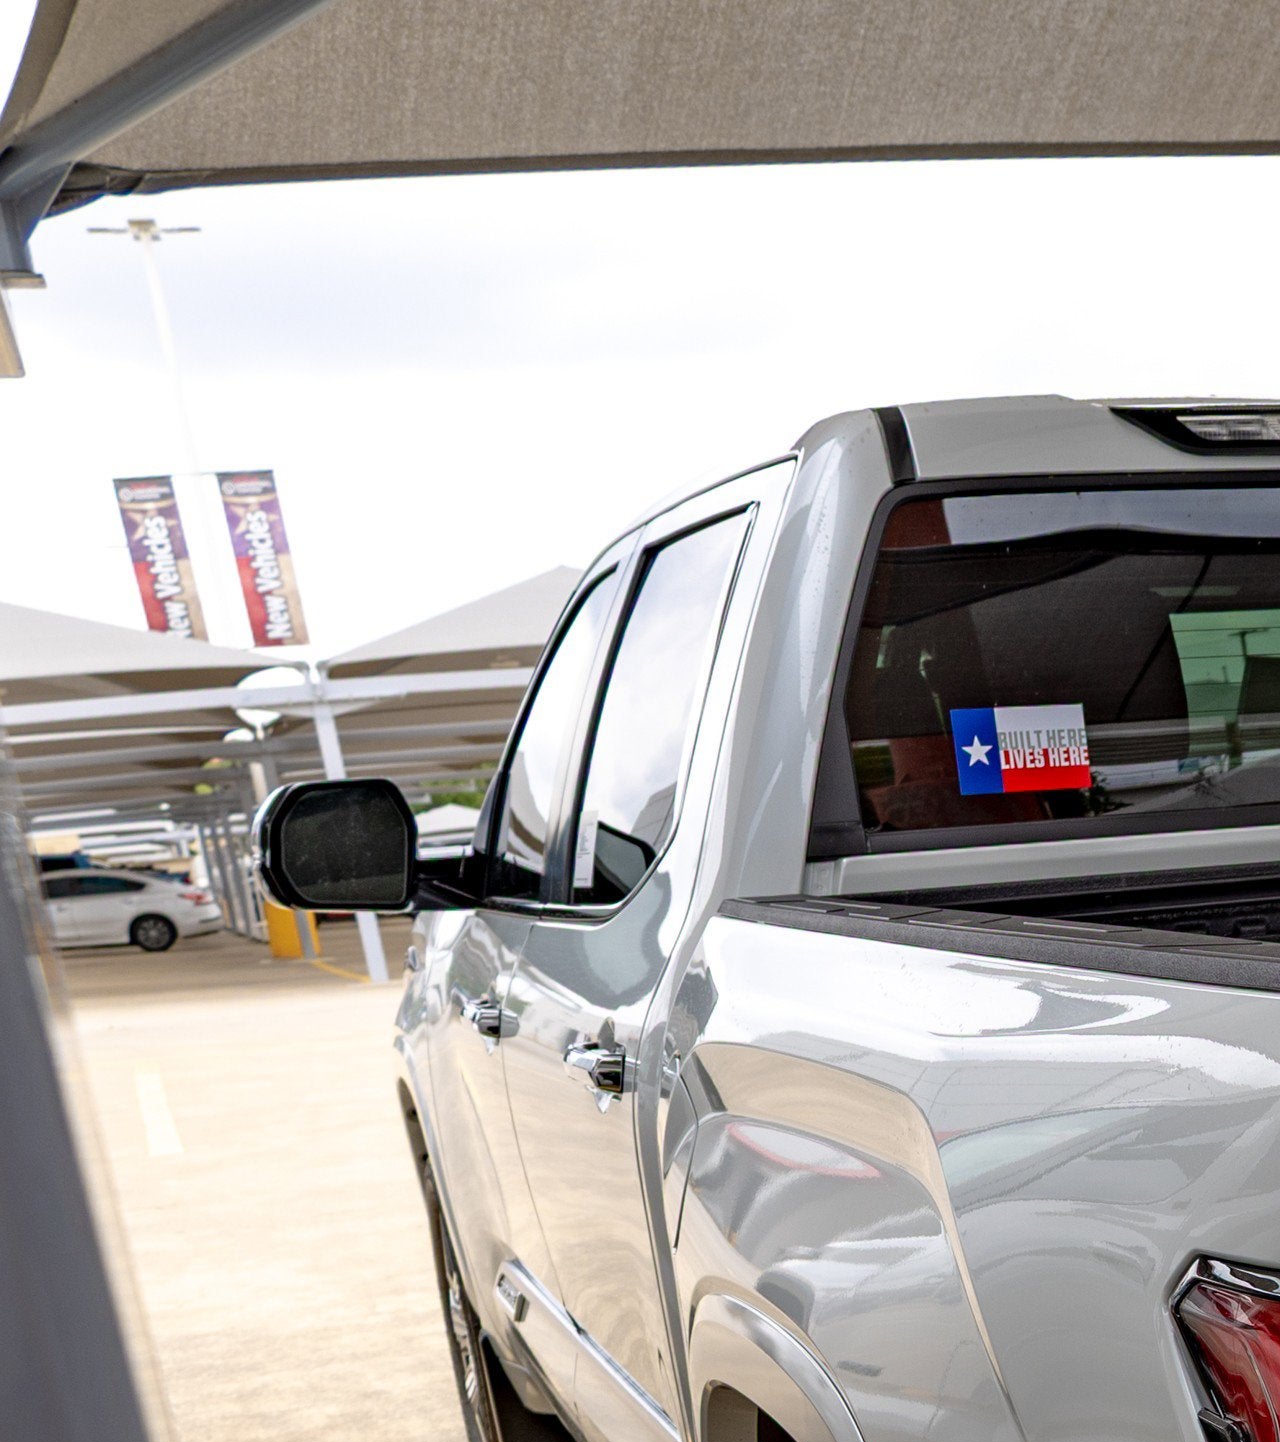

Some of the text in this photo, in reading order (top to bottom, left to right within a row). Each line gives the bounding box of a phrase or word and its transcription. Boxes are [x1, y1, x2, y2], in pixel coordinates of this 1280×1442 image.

[143, 516, 182, 599] Vehicles
[244, 510, 281, 594] Vehicles
[264, 594, 293, 640] New
[997, 728, 1087, 750] BUILT HERE
[999, 746, 1090, 770] LIVES HERE
